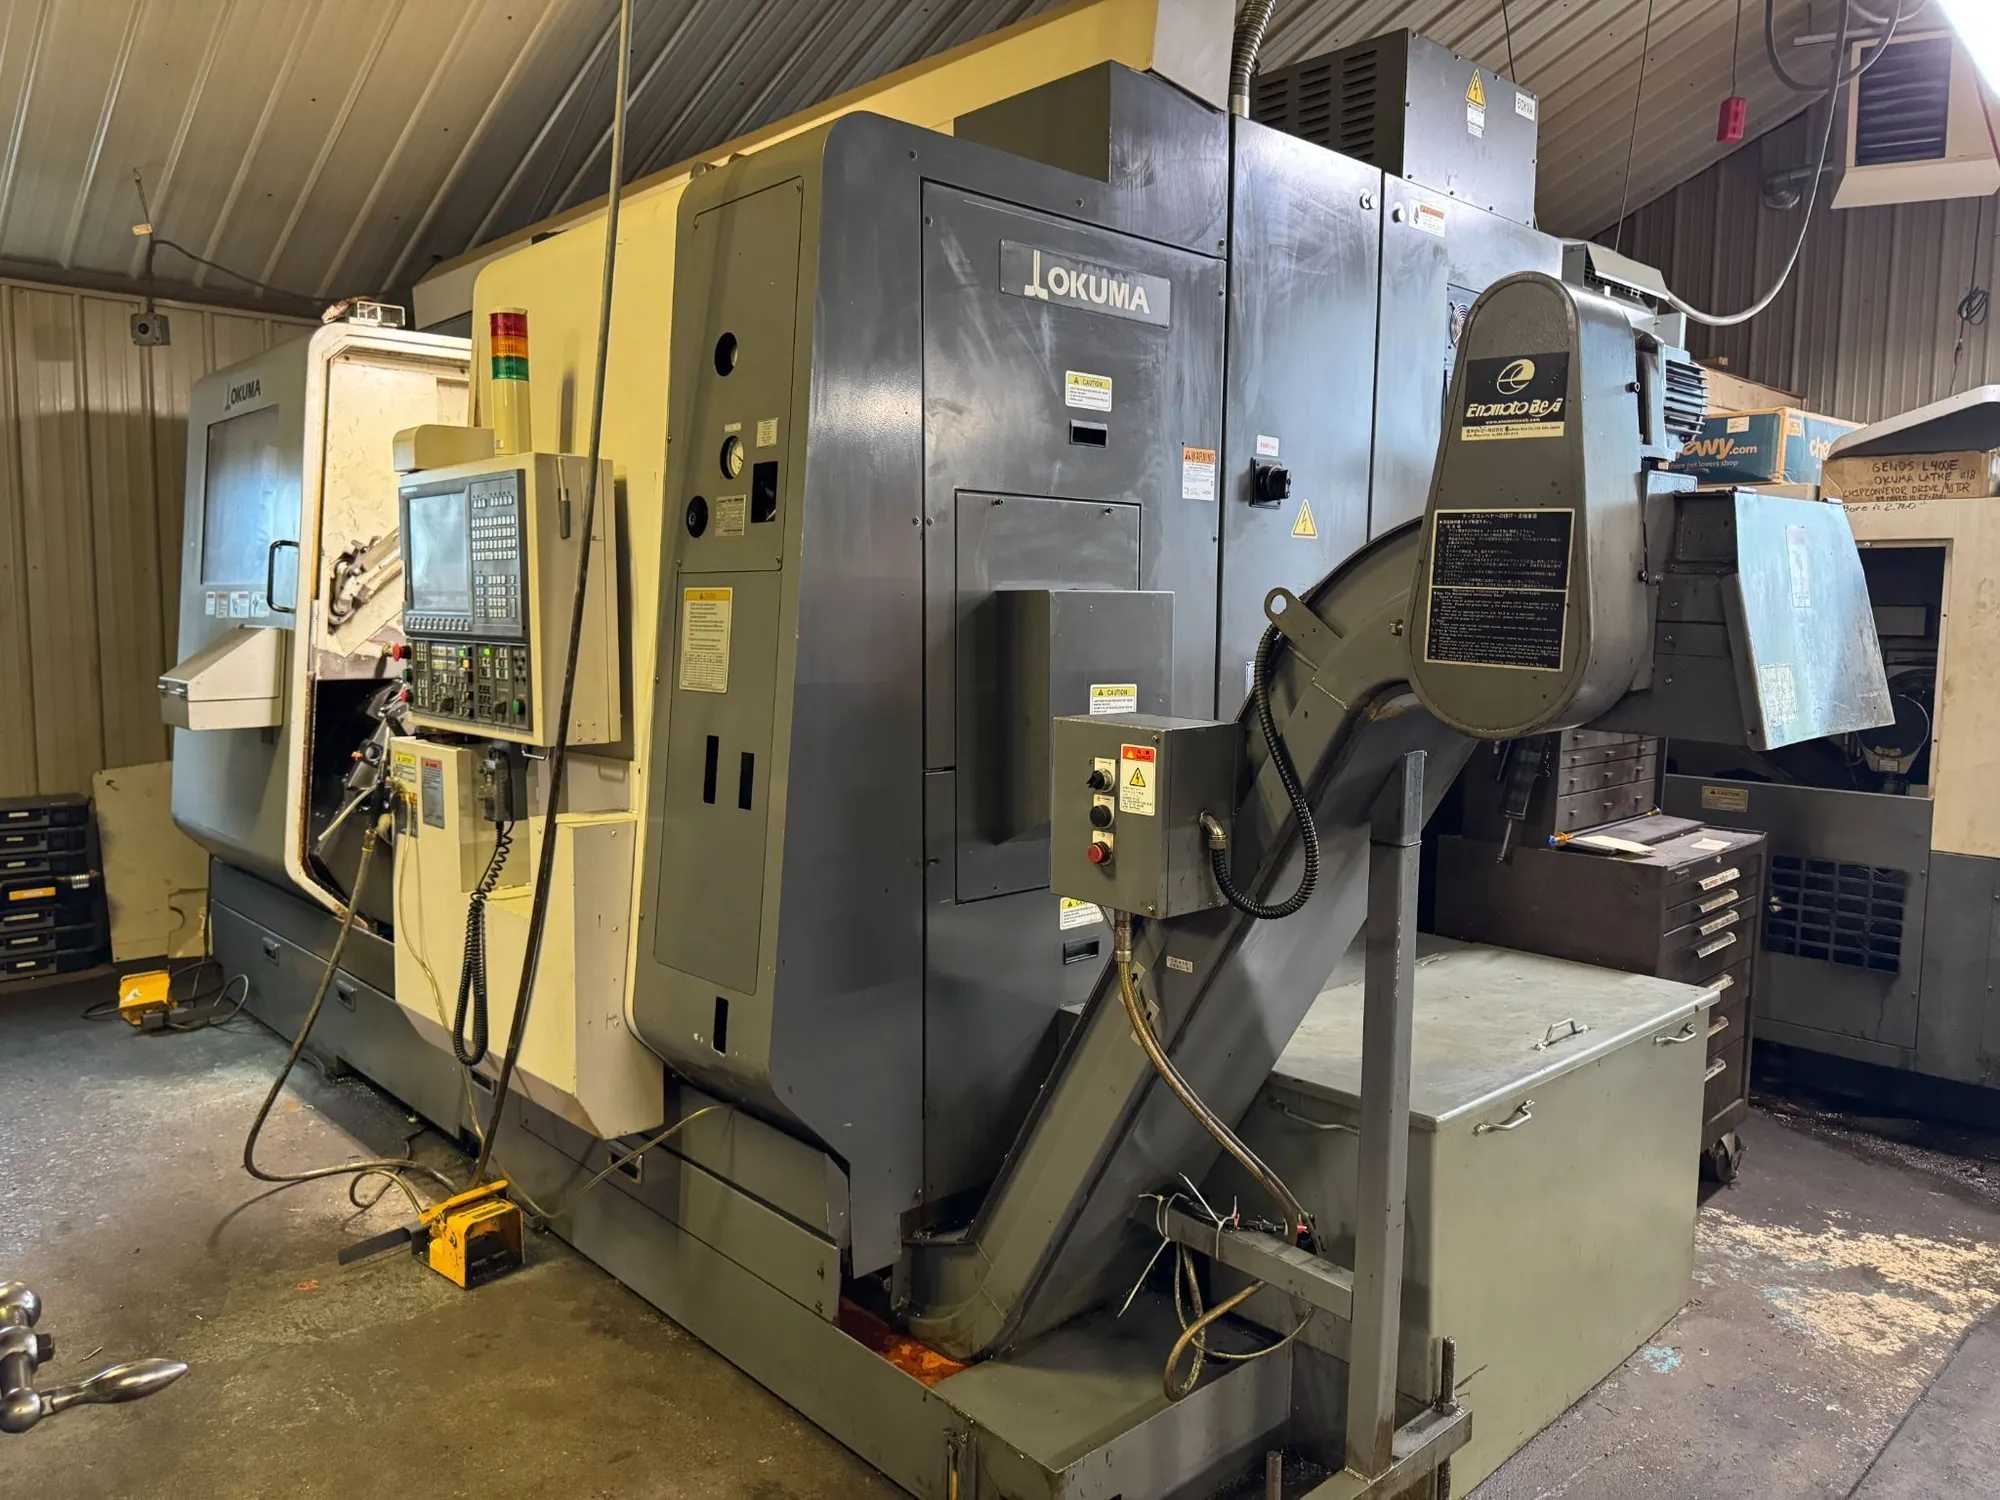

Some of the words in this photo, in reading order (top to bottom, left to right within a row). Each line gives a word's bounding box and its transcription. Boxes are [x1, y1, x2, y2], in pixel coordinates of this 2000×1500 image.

[1047, 266, 1150, 314] OKUMA
[231, 379, 261, 404] OKUMA
[1874, 474, 1915, 486] OKUMA
[1919, 472, 1951, 482] LATHE
